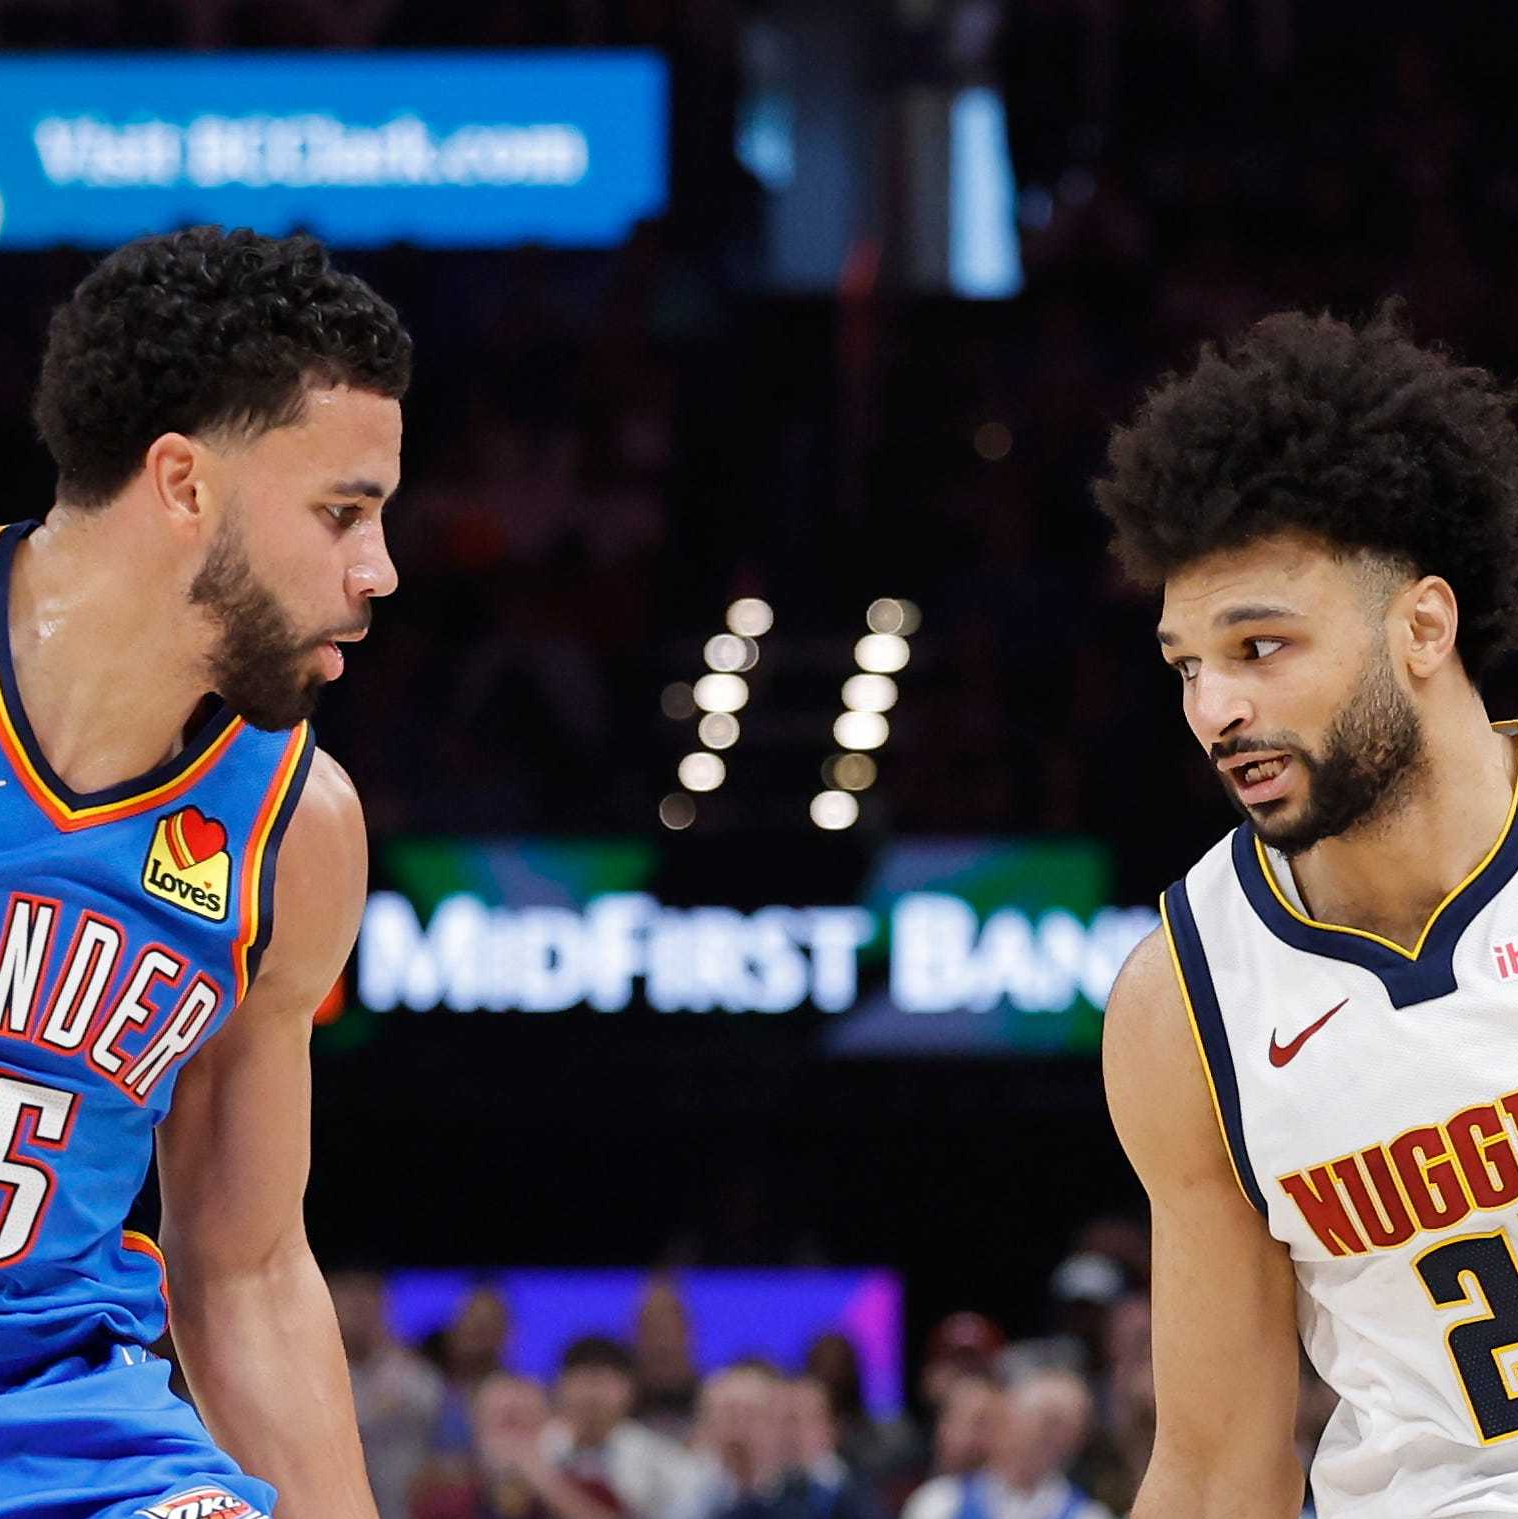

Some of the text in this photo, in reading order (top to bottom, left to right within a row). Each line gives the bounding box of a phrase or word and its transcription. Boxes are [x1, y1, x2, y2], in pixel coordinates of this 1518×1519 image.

[36, 115, 589, 187] Visit BCClark.com
[889, 892, 1162, 1014] BAN
